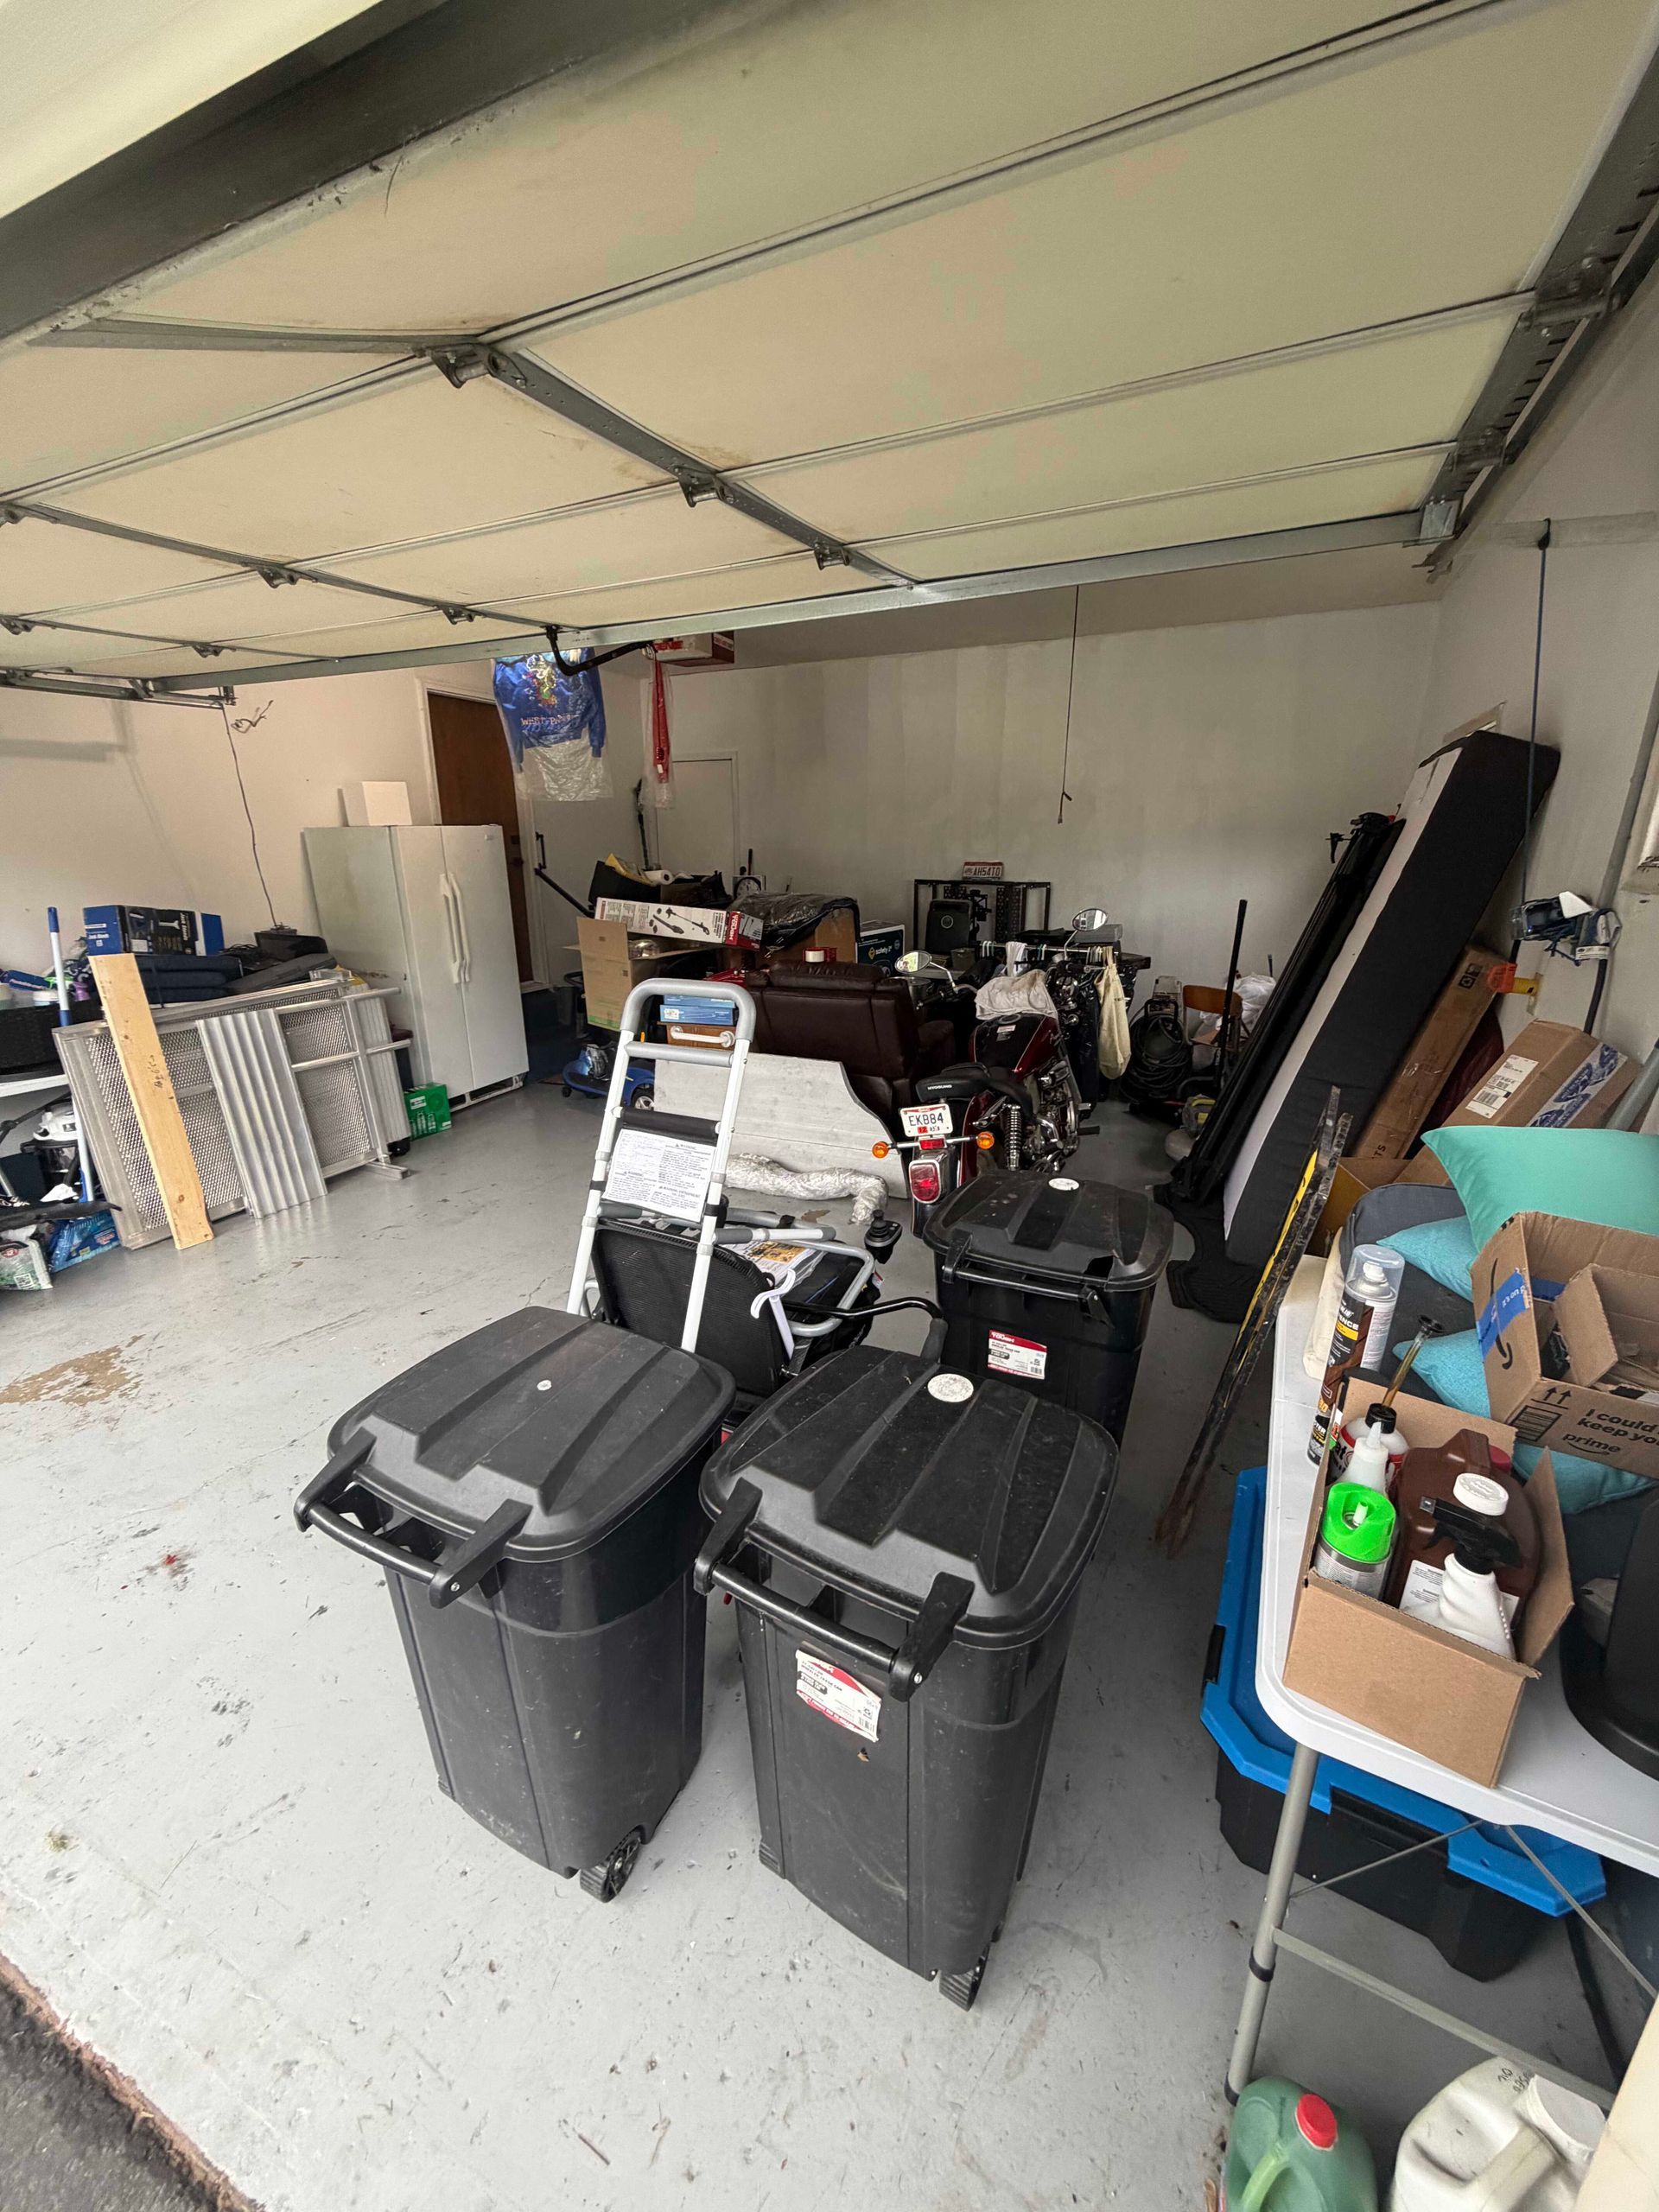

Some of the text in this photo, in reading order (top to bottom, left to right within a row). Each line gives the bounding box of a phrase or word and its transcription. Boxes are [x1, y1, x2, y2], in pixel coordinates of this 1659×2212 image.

[1510, 1289, 1520, 1299] on
[1577, 1418, 1629, 1436] keep
[1596, 1413, 1659, 1433] could
[1563, 1433, 1621, 1452] prime
